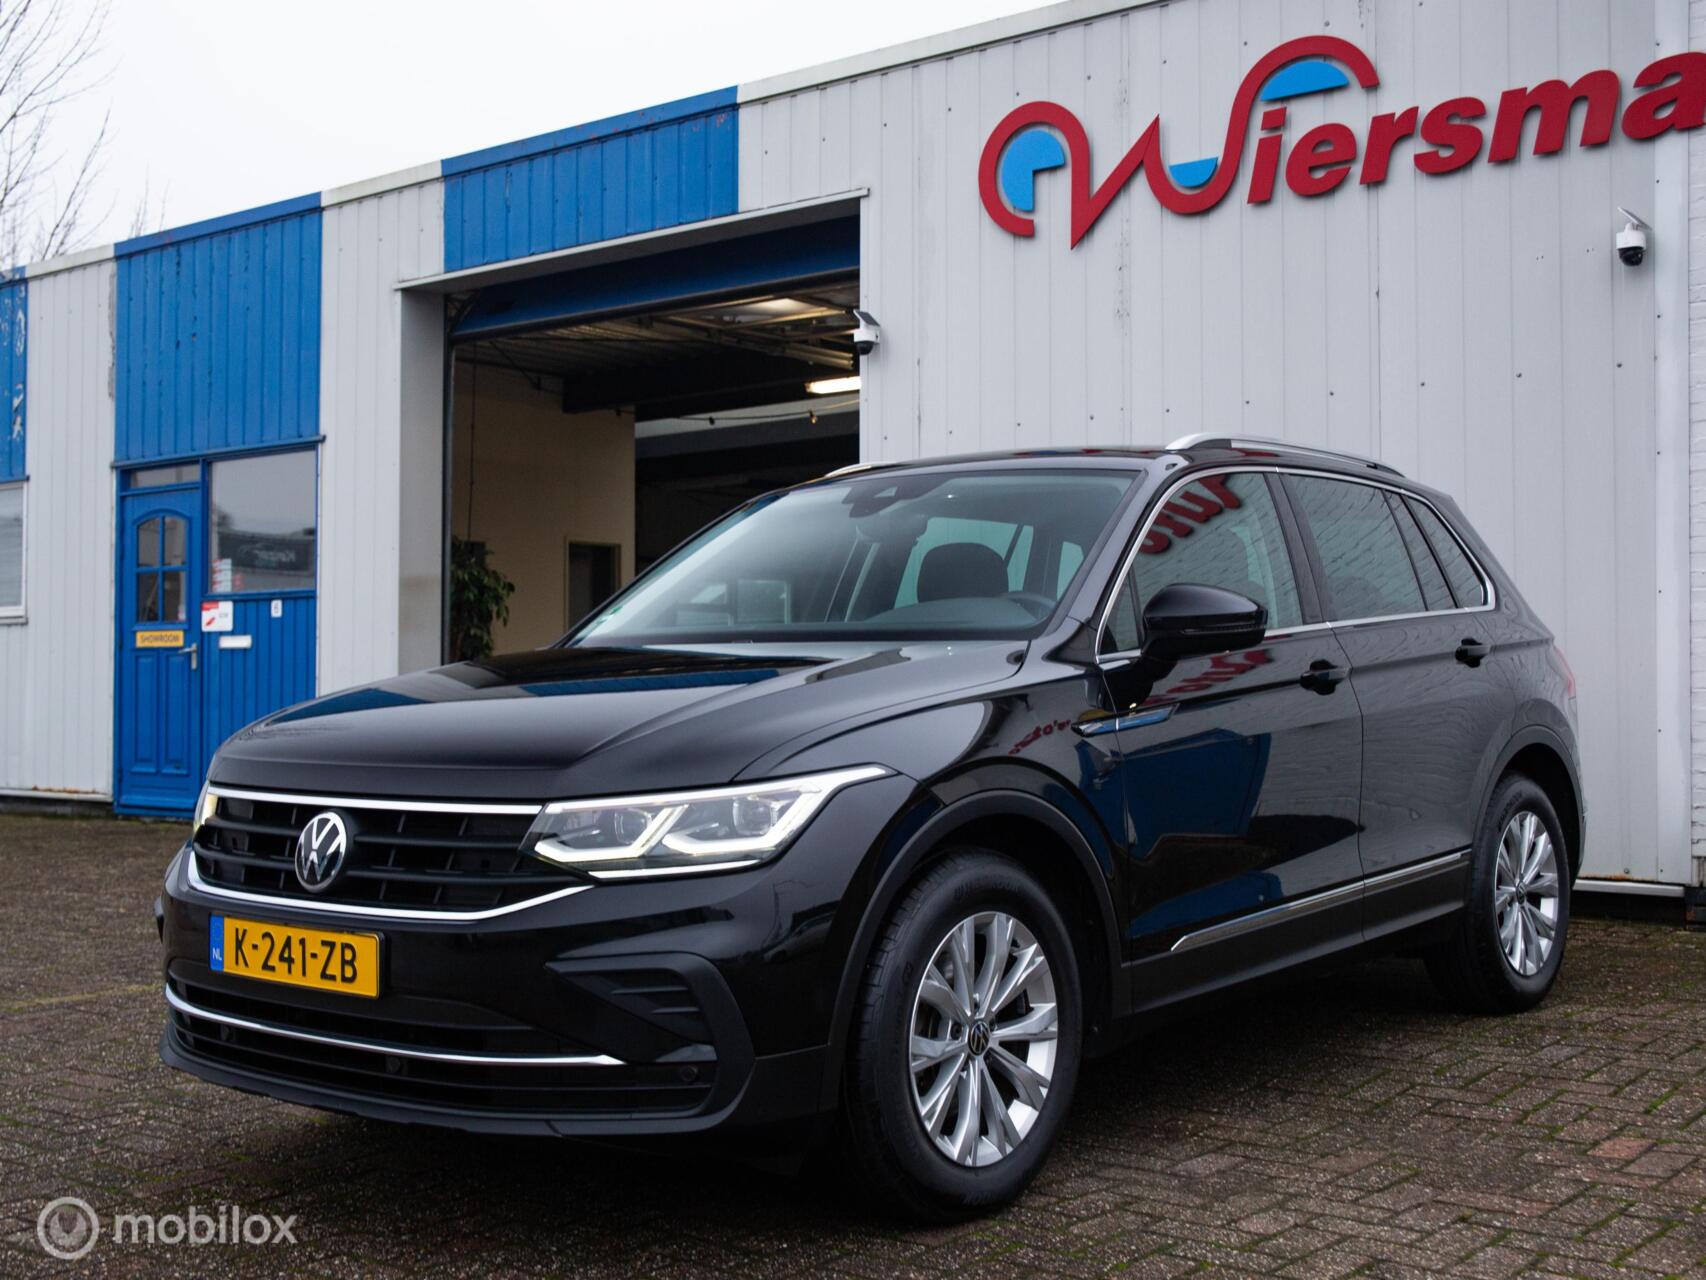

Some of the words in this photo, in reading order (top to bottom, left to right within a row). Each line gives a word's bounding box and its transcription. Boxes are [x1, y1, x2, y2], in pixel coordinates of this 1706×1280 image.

[978, 35, 1706, 249] Wiersma
[212, 949, 223, 961] NL
[234, 927, 358, 984] K-241-ZB
